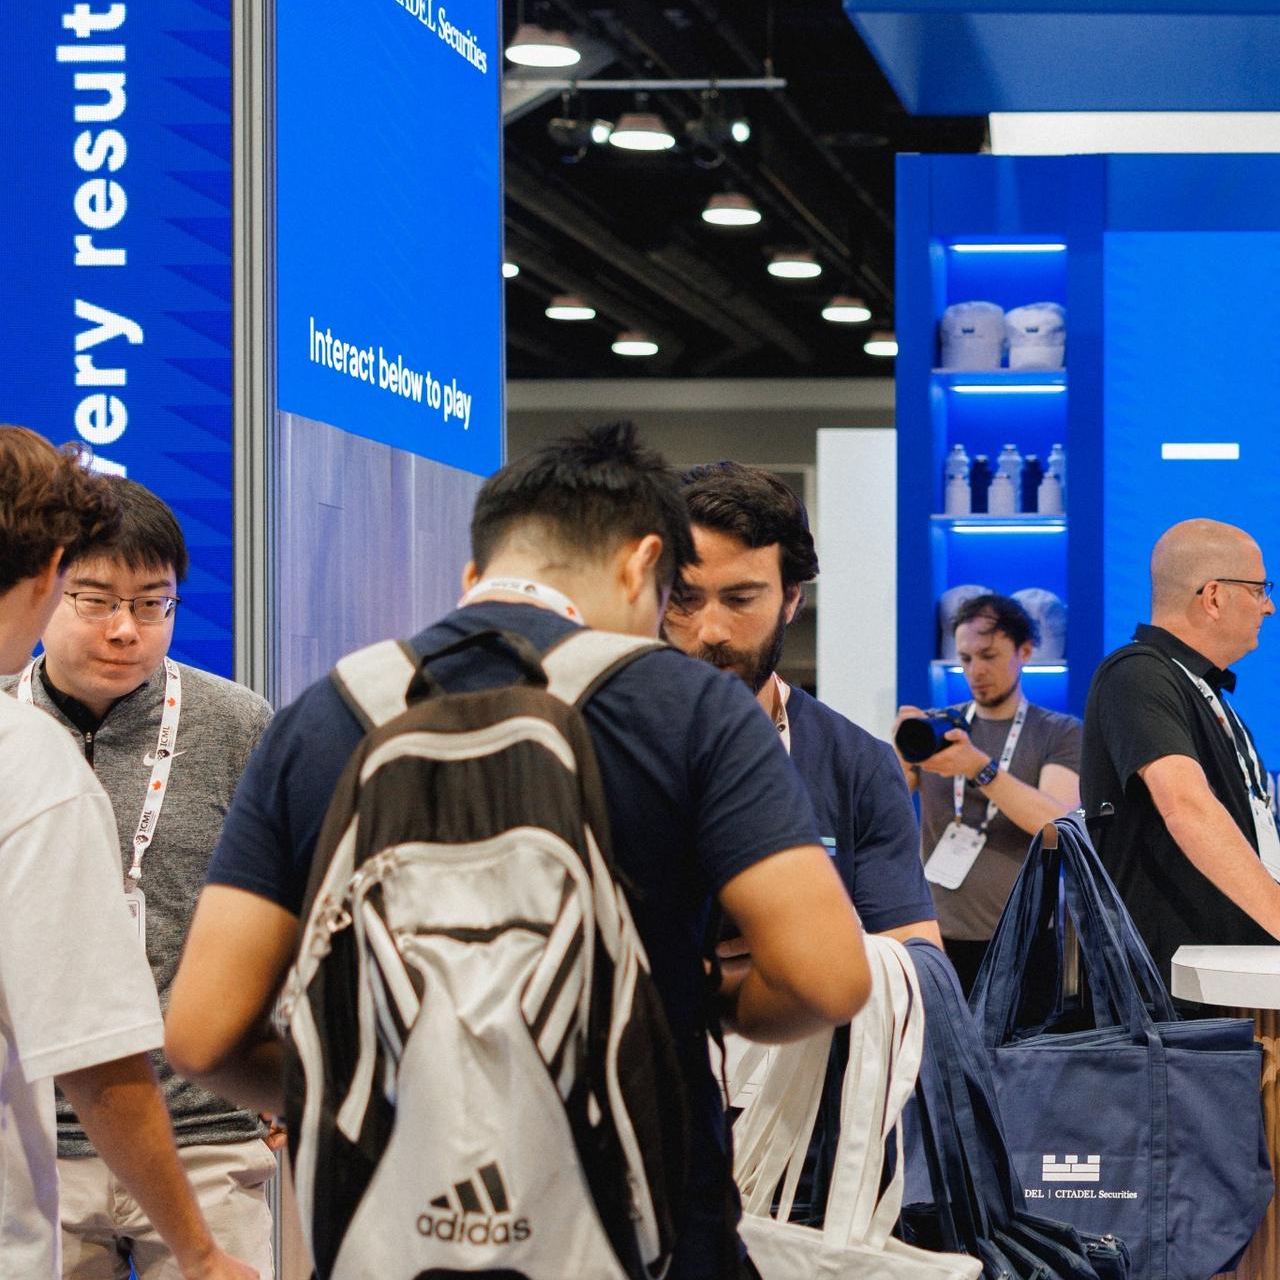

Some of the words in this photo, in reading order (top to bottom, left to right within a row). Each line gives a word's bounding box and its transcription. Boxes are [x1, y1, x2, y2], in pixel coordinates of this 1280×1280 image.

[438, 7, 488, 75] Securities
[55, 3, 127, 266] result
[309, 316, 375, 385] Interact
[379, 346, 423, 403] below
[425, 371, 441, 410] to
[443, 378, 472, 431] play
[159, 725, 171, 748] ICML
[139, 810, 152, 833] ICML
[1054, 1189, 1097, 1199] CITADEL
[1098, 1189, 1138, 1199] Securities
[416, 1209, 532, 1246] adidas
